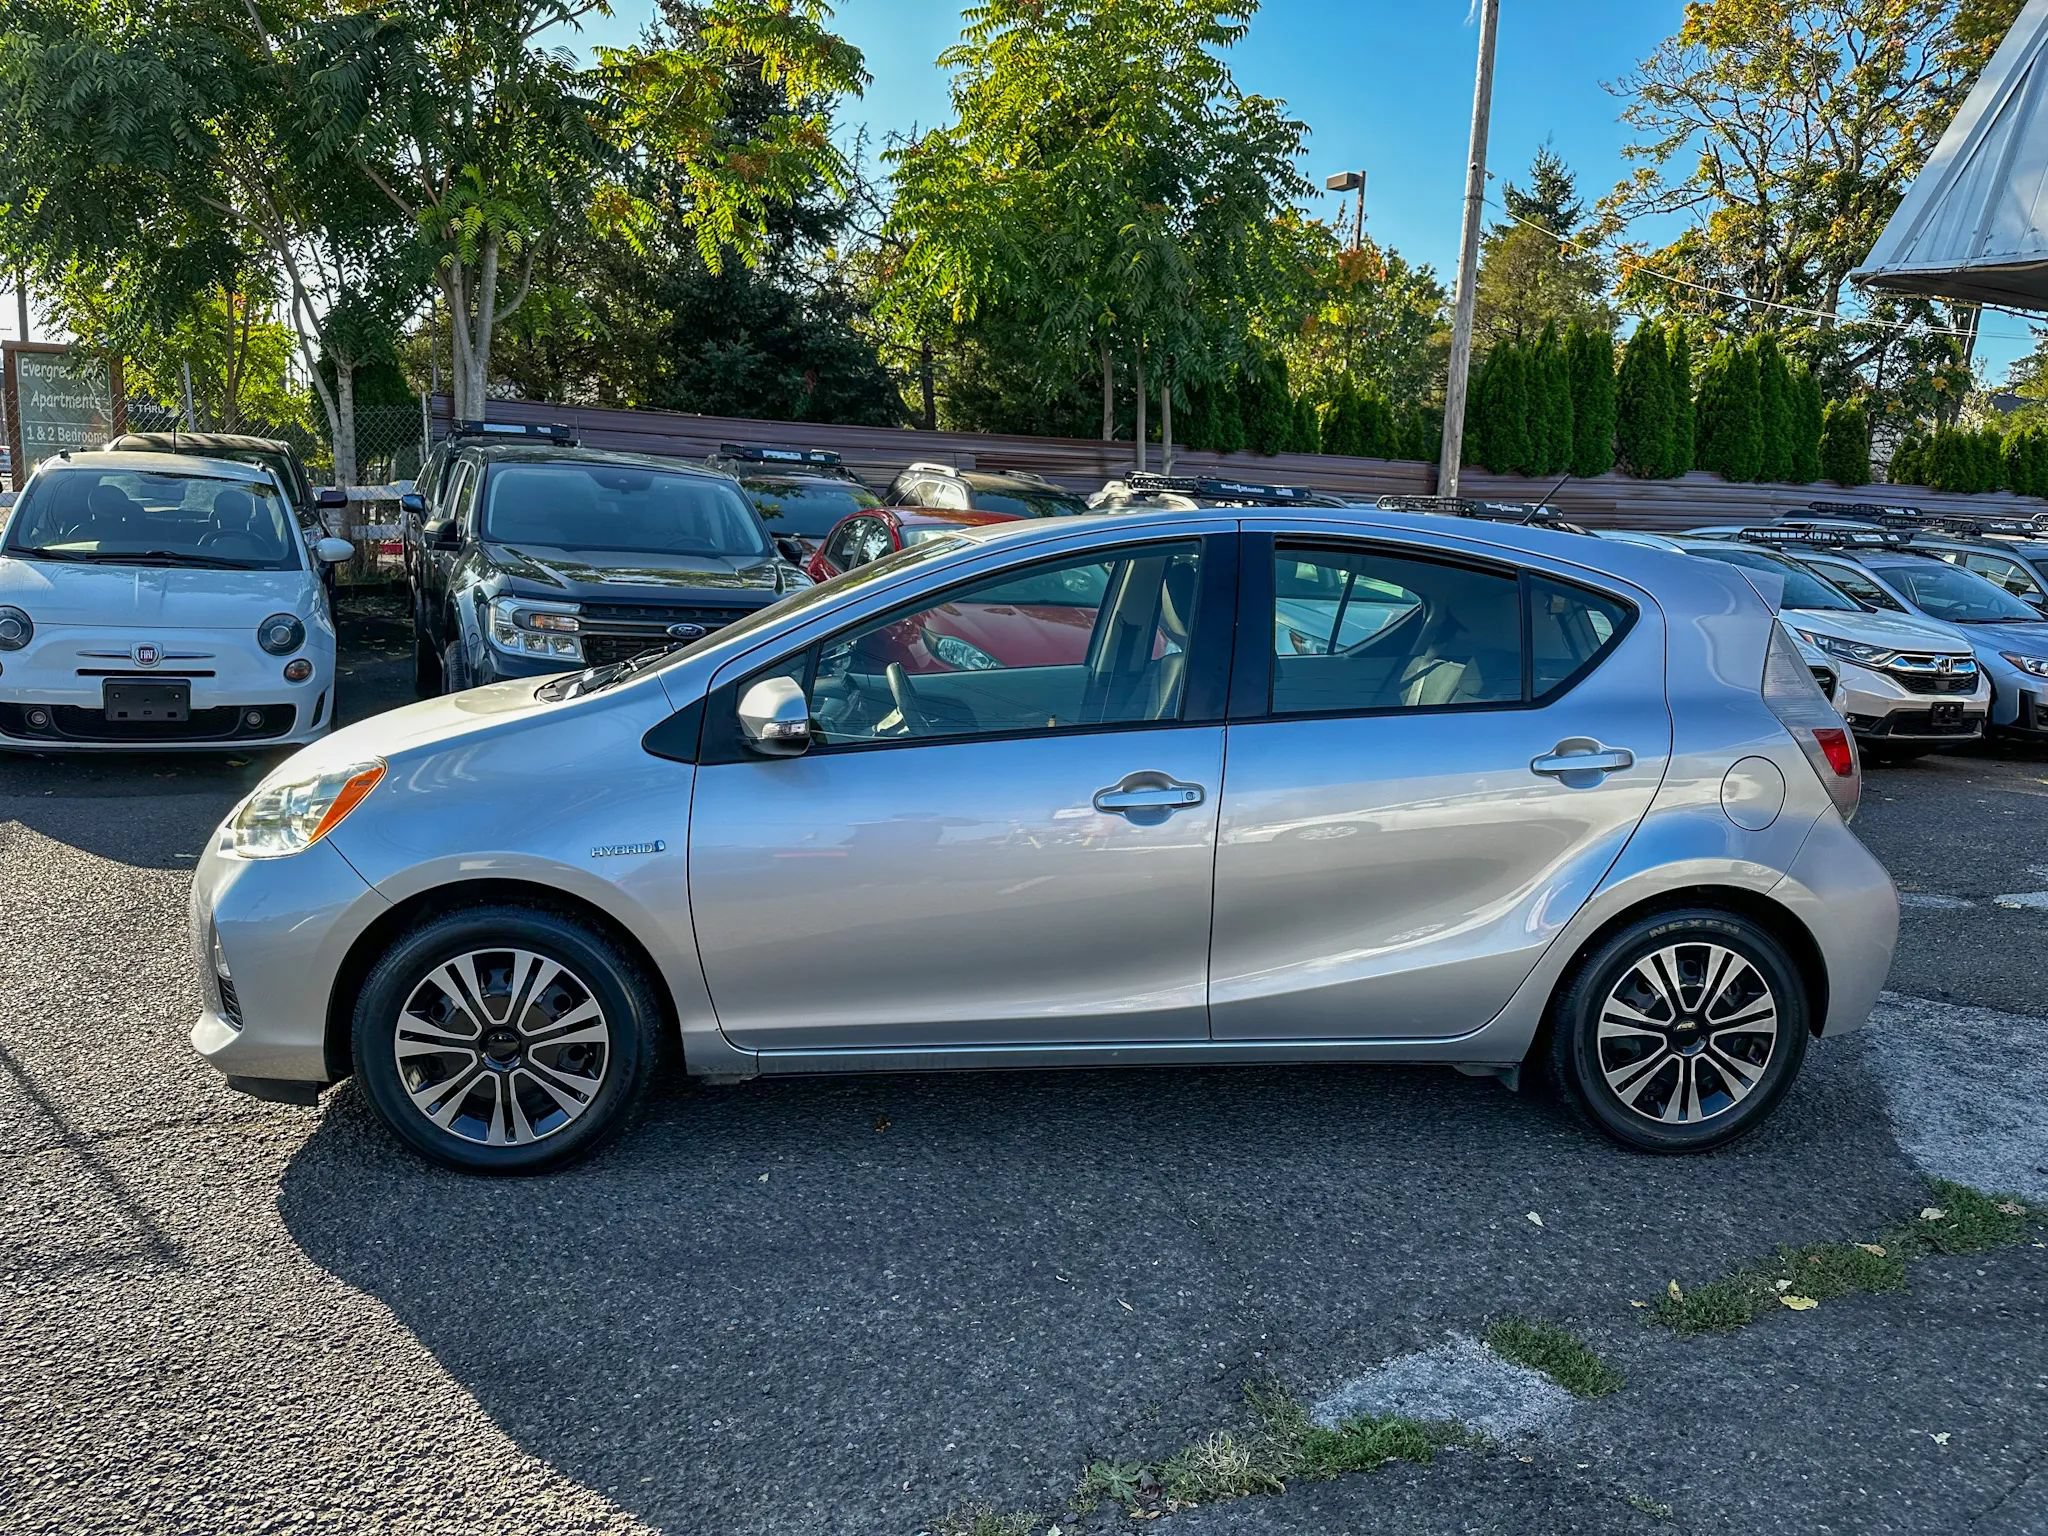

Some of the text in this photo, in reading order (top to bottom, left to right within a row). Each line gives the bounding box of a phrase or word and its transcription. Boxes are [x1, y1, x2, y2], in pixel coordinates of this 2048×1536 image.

[20, 357, 78, 382] Evergre
[30, 389, 101, 411] Apartments
[138, 404, 166, 414] THRU
[26, 425, 109, 443] 1 & 2 Bedrooms
[140, 649, 154, 660] FIAT
[591, 843, 654, 858] HYBRID
[1648, 919, 1741, 939] NEXEN
